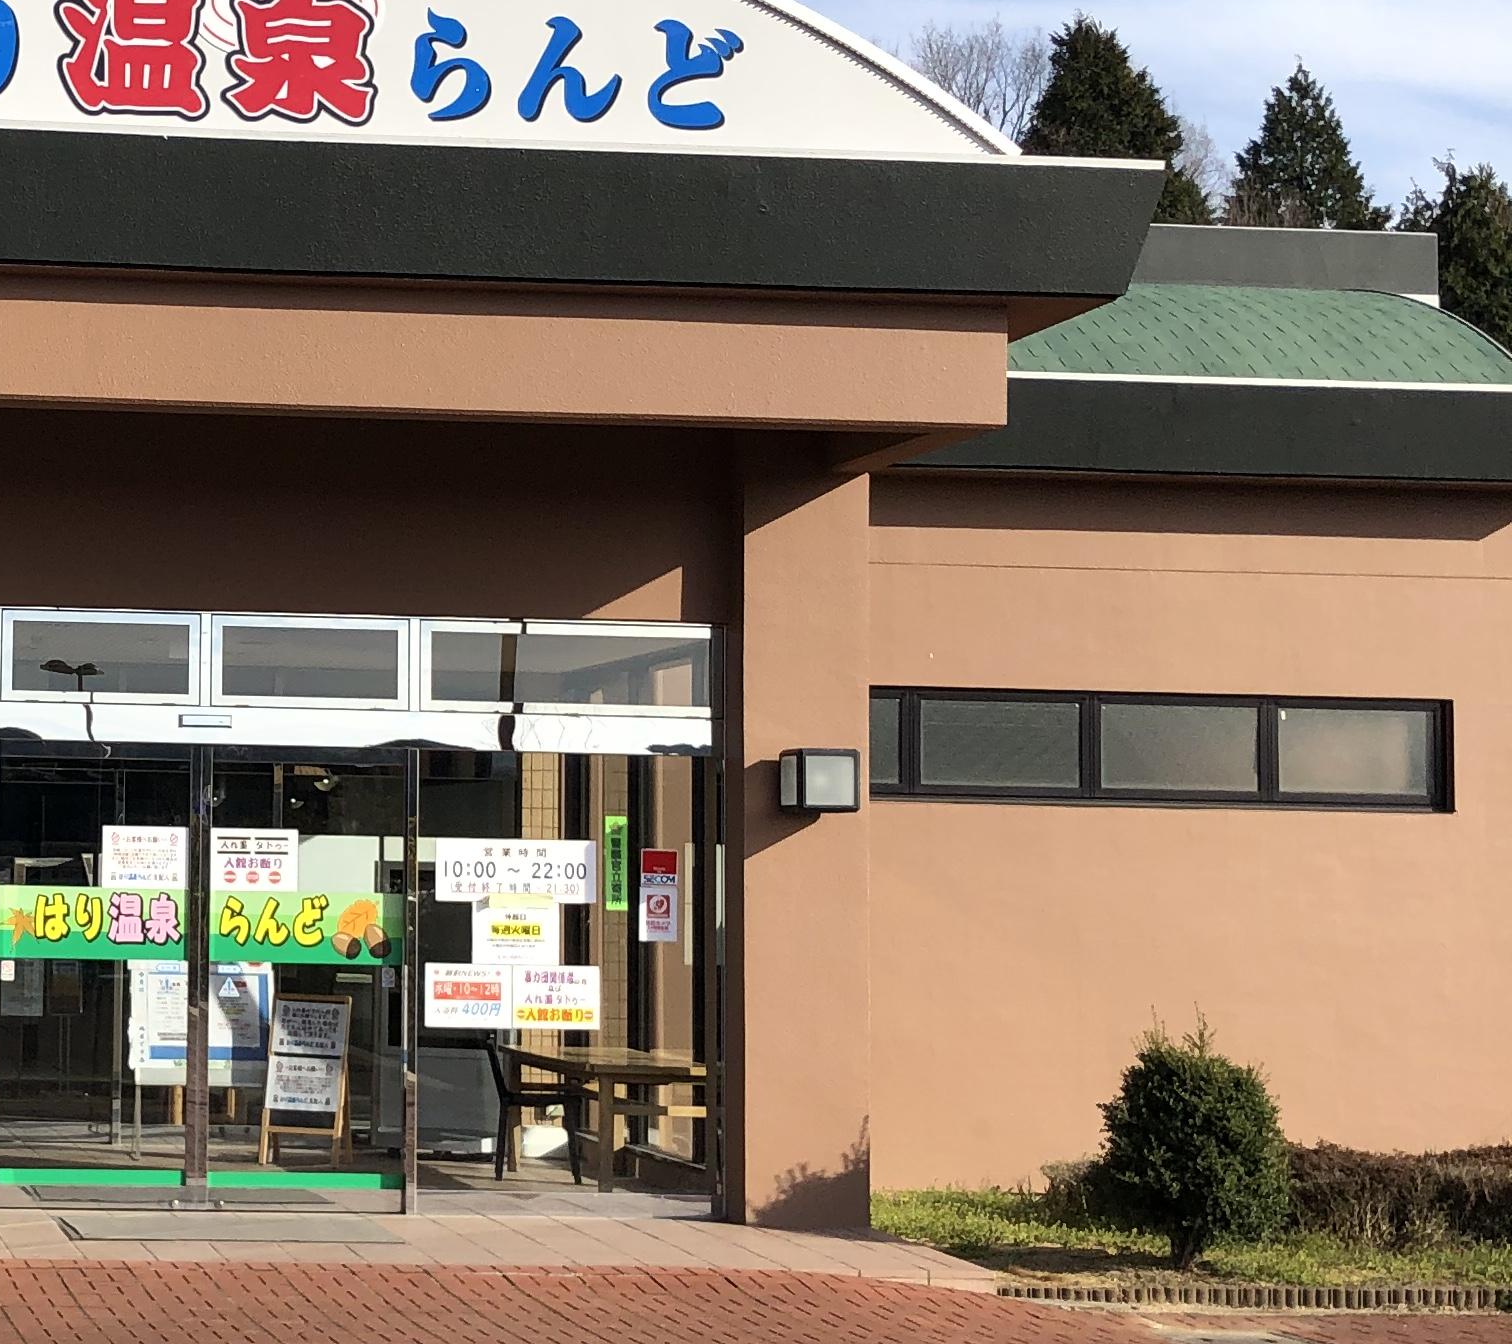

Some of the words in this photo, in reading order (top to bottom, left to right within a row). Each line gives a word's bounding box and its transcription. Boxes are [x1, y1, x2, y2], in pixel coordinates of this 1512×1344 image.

[483, 847, 547, 857] 営業時間
[224, 857, 282, 869] 入館お断り
[444, 860, 496, 878] 10:00
[531, 862, 587, 880] 22:00
[643, 874, 676, 884] SECOM
[35, 892, 182, 946] はり温泉
[219, 894, 330, 948] らんど
[491, 924, 541, 935] 毎週火曜日
[462, 1002, 502, 1016] 400円
[525, 1008, 584, 1022] 入館お断り
